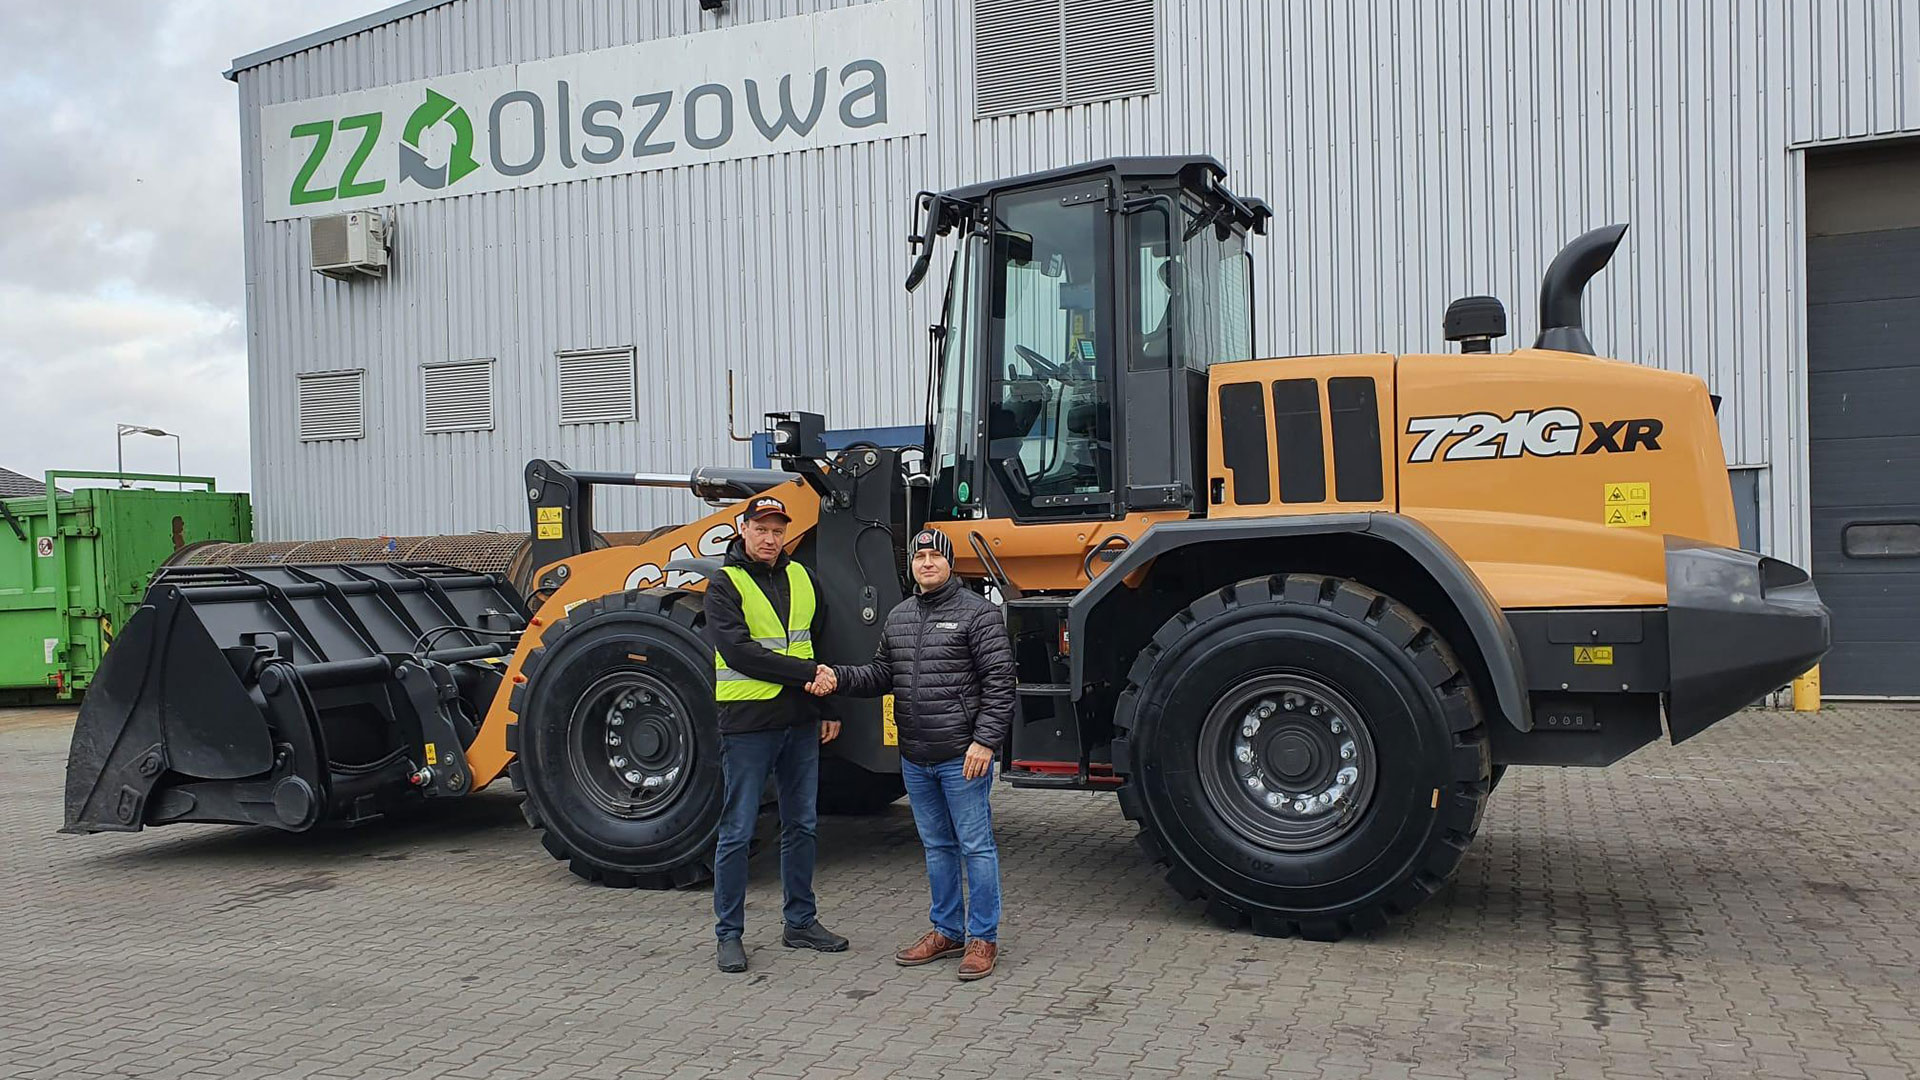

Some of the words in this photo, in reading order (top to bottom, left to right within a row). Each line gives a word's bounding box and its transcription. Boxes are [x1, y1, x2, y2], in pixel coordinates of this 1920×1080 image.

[489, 59, 888, 177] Olszowa
[1405, 406, 1583, 463] 721G
[1580, 418, 1663, 455] XR
